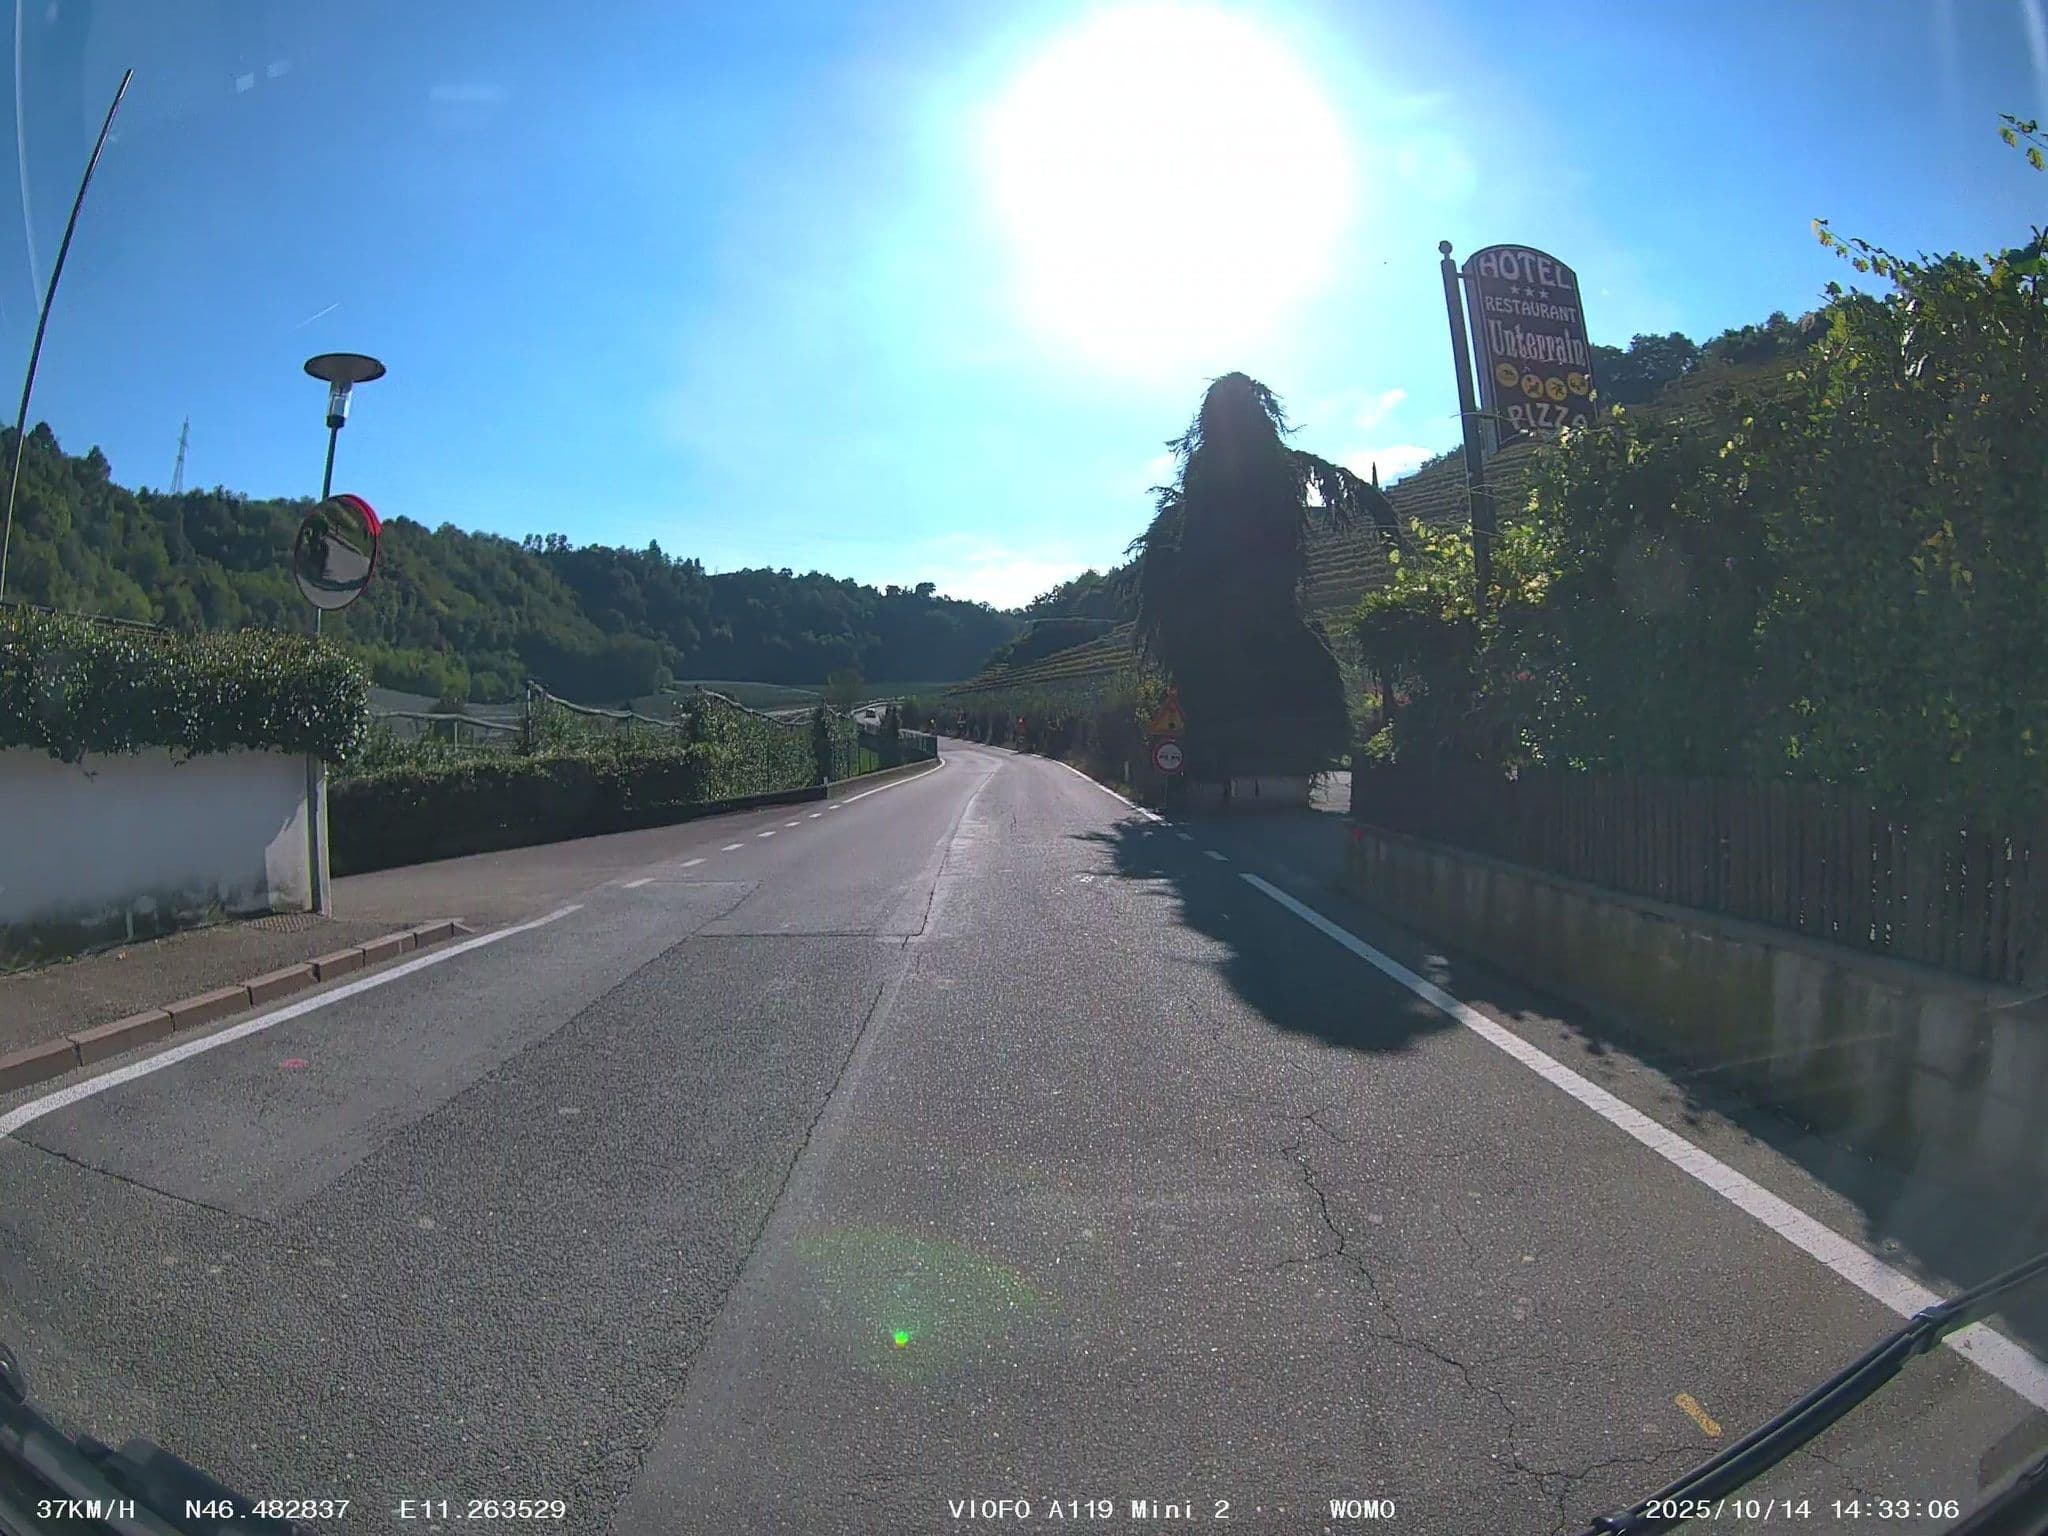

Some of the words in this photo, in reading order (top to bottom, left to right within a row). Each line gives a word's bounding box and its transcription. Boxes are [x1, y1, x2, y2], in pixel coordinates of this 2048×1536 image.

[1479, 250, 1571, 290] HOTEL
[1485, 295, 1578, 322] RESTAURANT
[1488, 319, 1586, 367] Unterrain
